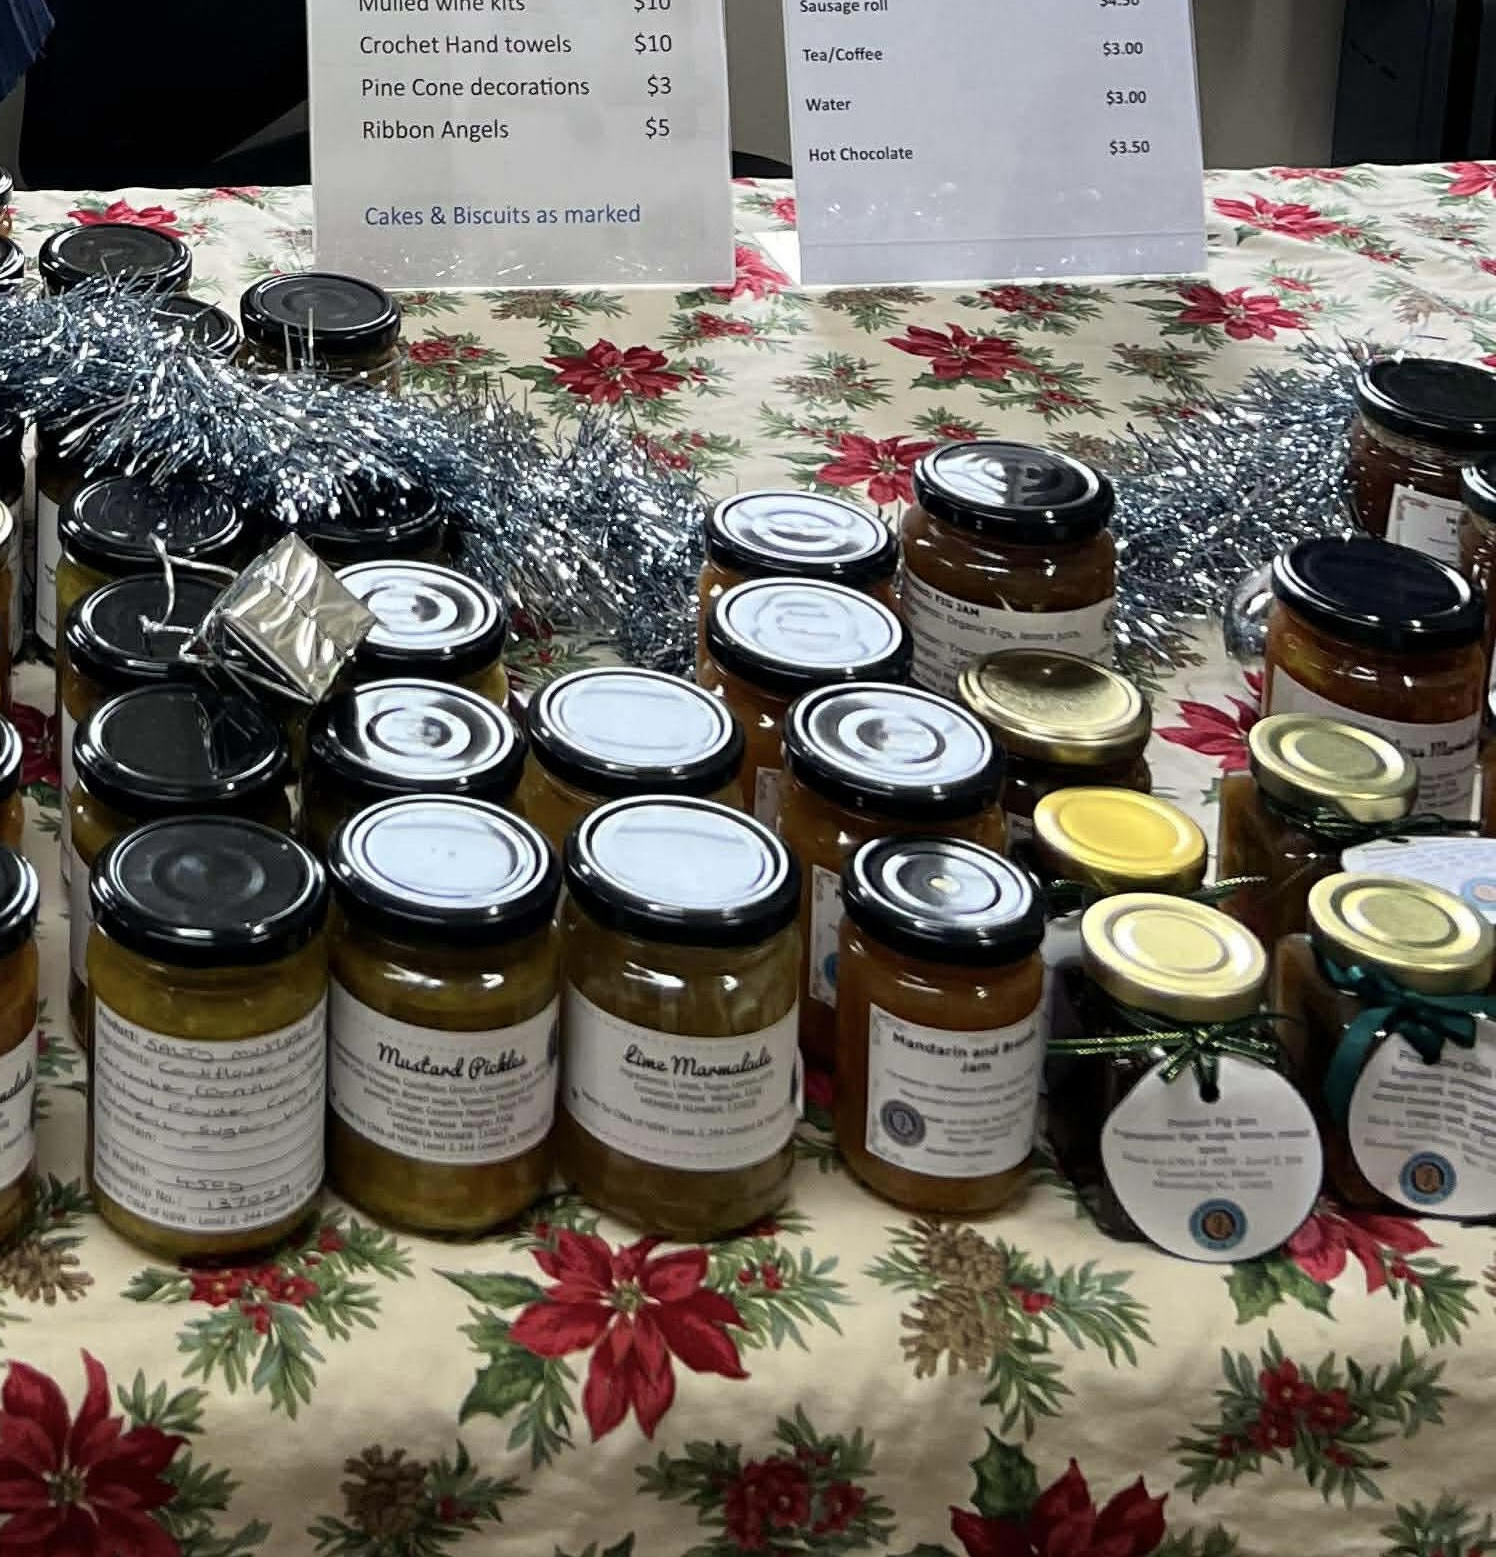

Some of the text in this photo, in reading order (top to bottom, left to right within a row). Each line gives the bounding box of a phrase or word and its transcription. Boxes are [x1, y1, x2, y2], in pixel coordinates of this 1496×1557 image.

[799, 0, 860, 16] Sausage
[360, 33, 572, 55] Crochet Hand towels
[634, 32, 672, 56] $10
[1102, 41, 1144, 57] $3.00
[801, 46, 883, 64] Tea/Coffee
[362, 76, 590, 97] Pine Cone decorations
[647, 73, 672, 98] $3
[805, 98, 852, 112] Water
[1106, 89, 1147, 106] $3.00
[363, 118, 509, 143] Ribbon Angels
[645, 116, 670, 140] $5
[808, 145, 913, 162] Hot Chocolate
[1109, 140, 1150, 156] $3.50
[364, 203, 641, 226] Cakes & Biscuits as marked
[892, 1031, 999, 1058] Mandarin and
[377, 1042, 527, 1080] Mustard Pickles
[623, 1044, 667, 1072] Lime
[960, 1060, 991, 1074] Jam
